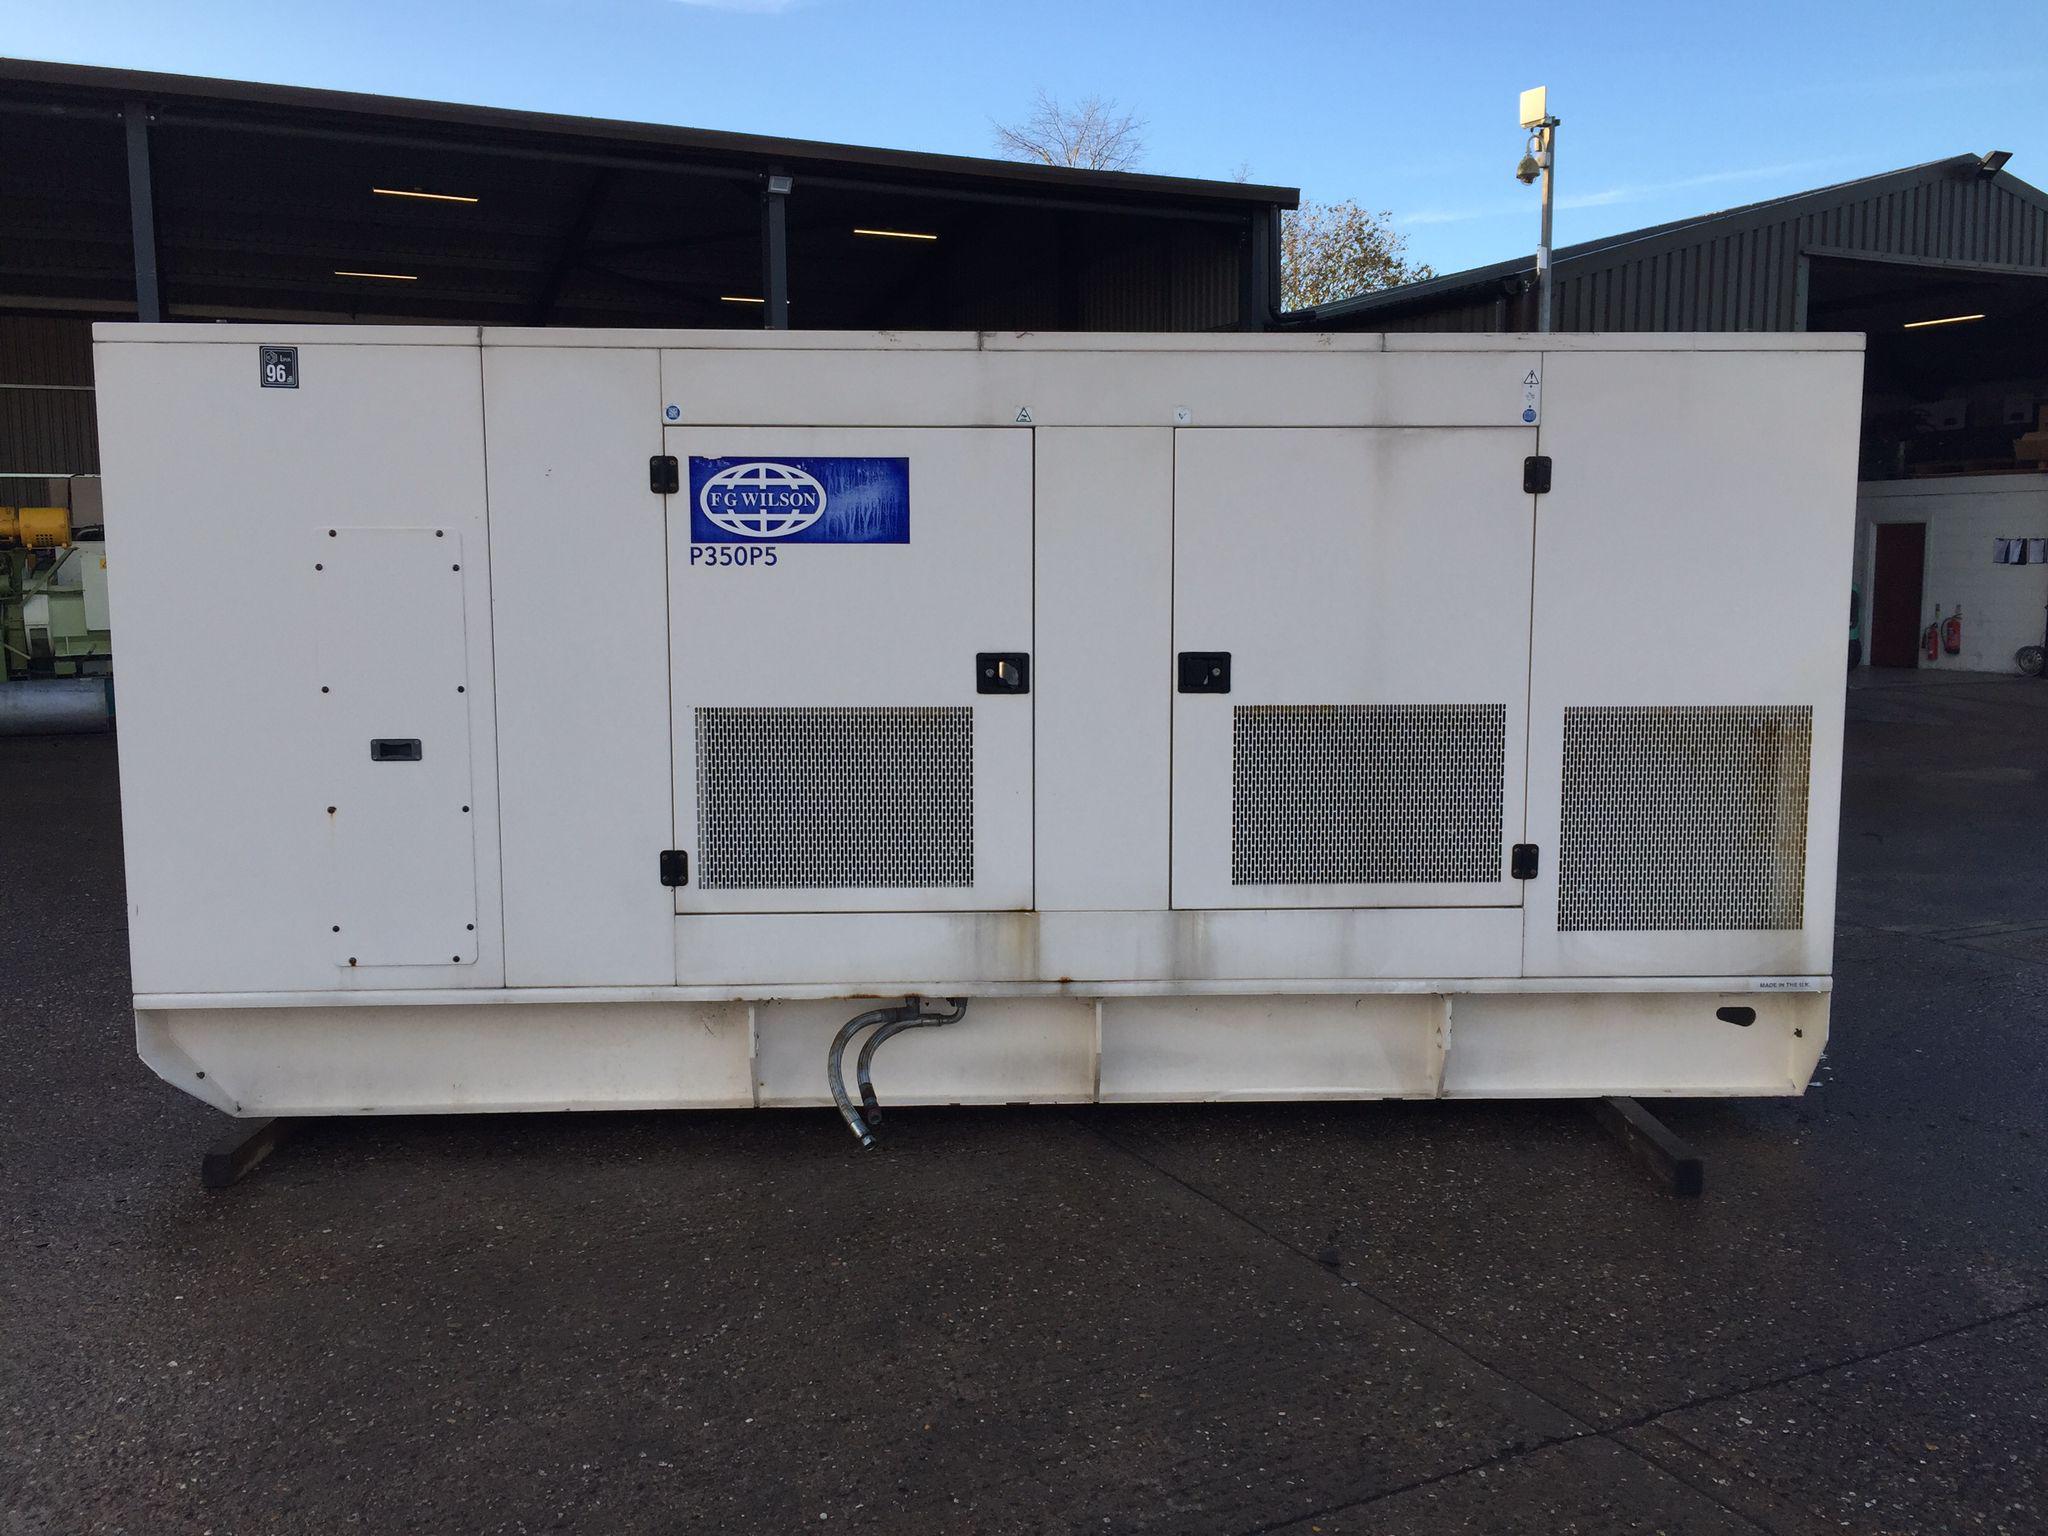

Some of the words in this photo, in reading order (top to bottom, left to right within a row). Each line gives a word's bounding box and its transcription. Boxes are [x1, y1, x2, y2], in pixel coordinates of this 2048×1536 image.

[266, 364, 286, 382] 96
[741, 492, 816, 507] WILSON
[690, 546, 778, 566] P350P5
